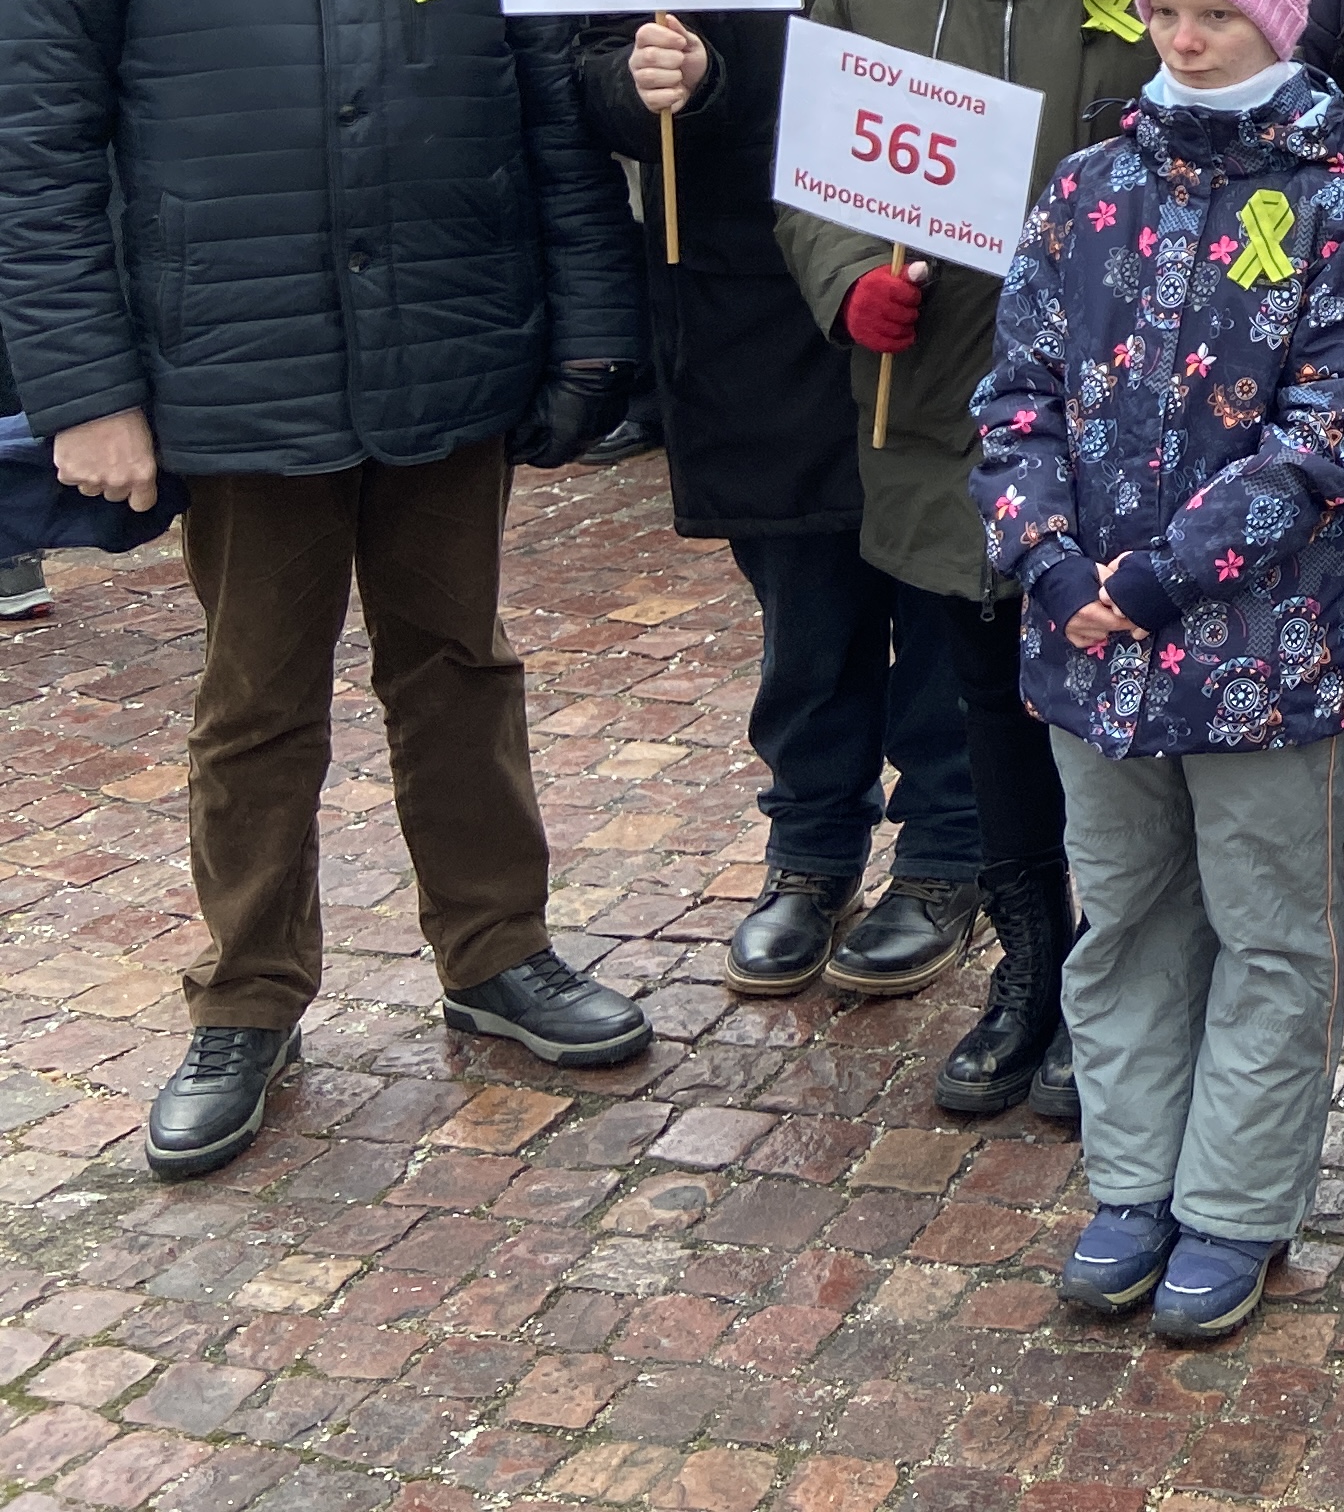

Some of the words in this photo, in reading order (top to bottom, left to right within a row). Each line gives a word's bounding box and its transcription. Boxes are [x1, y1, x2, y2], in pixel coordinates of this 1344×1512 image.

[841, 52, 902, 86] ГБОУ
[909, 76, 986, 116] школа
[851, 109, 958, 186] 565
[794, 168, 922, 228] Кировский
[928, 218, 1004, 255] район
